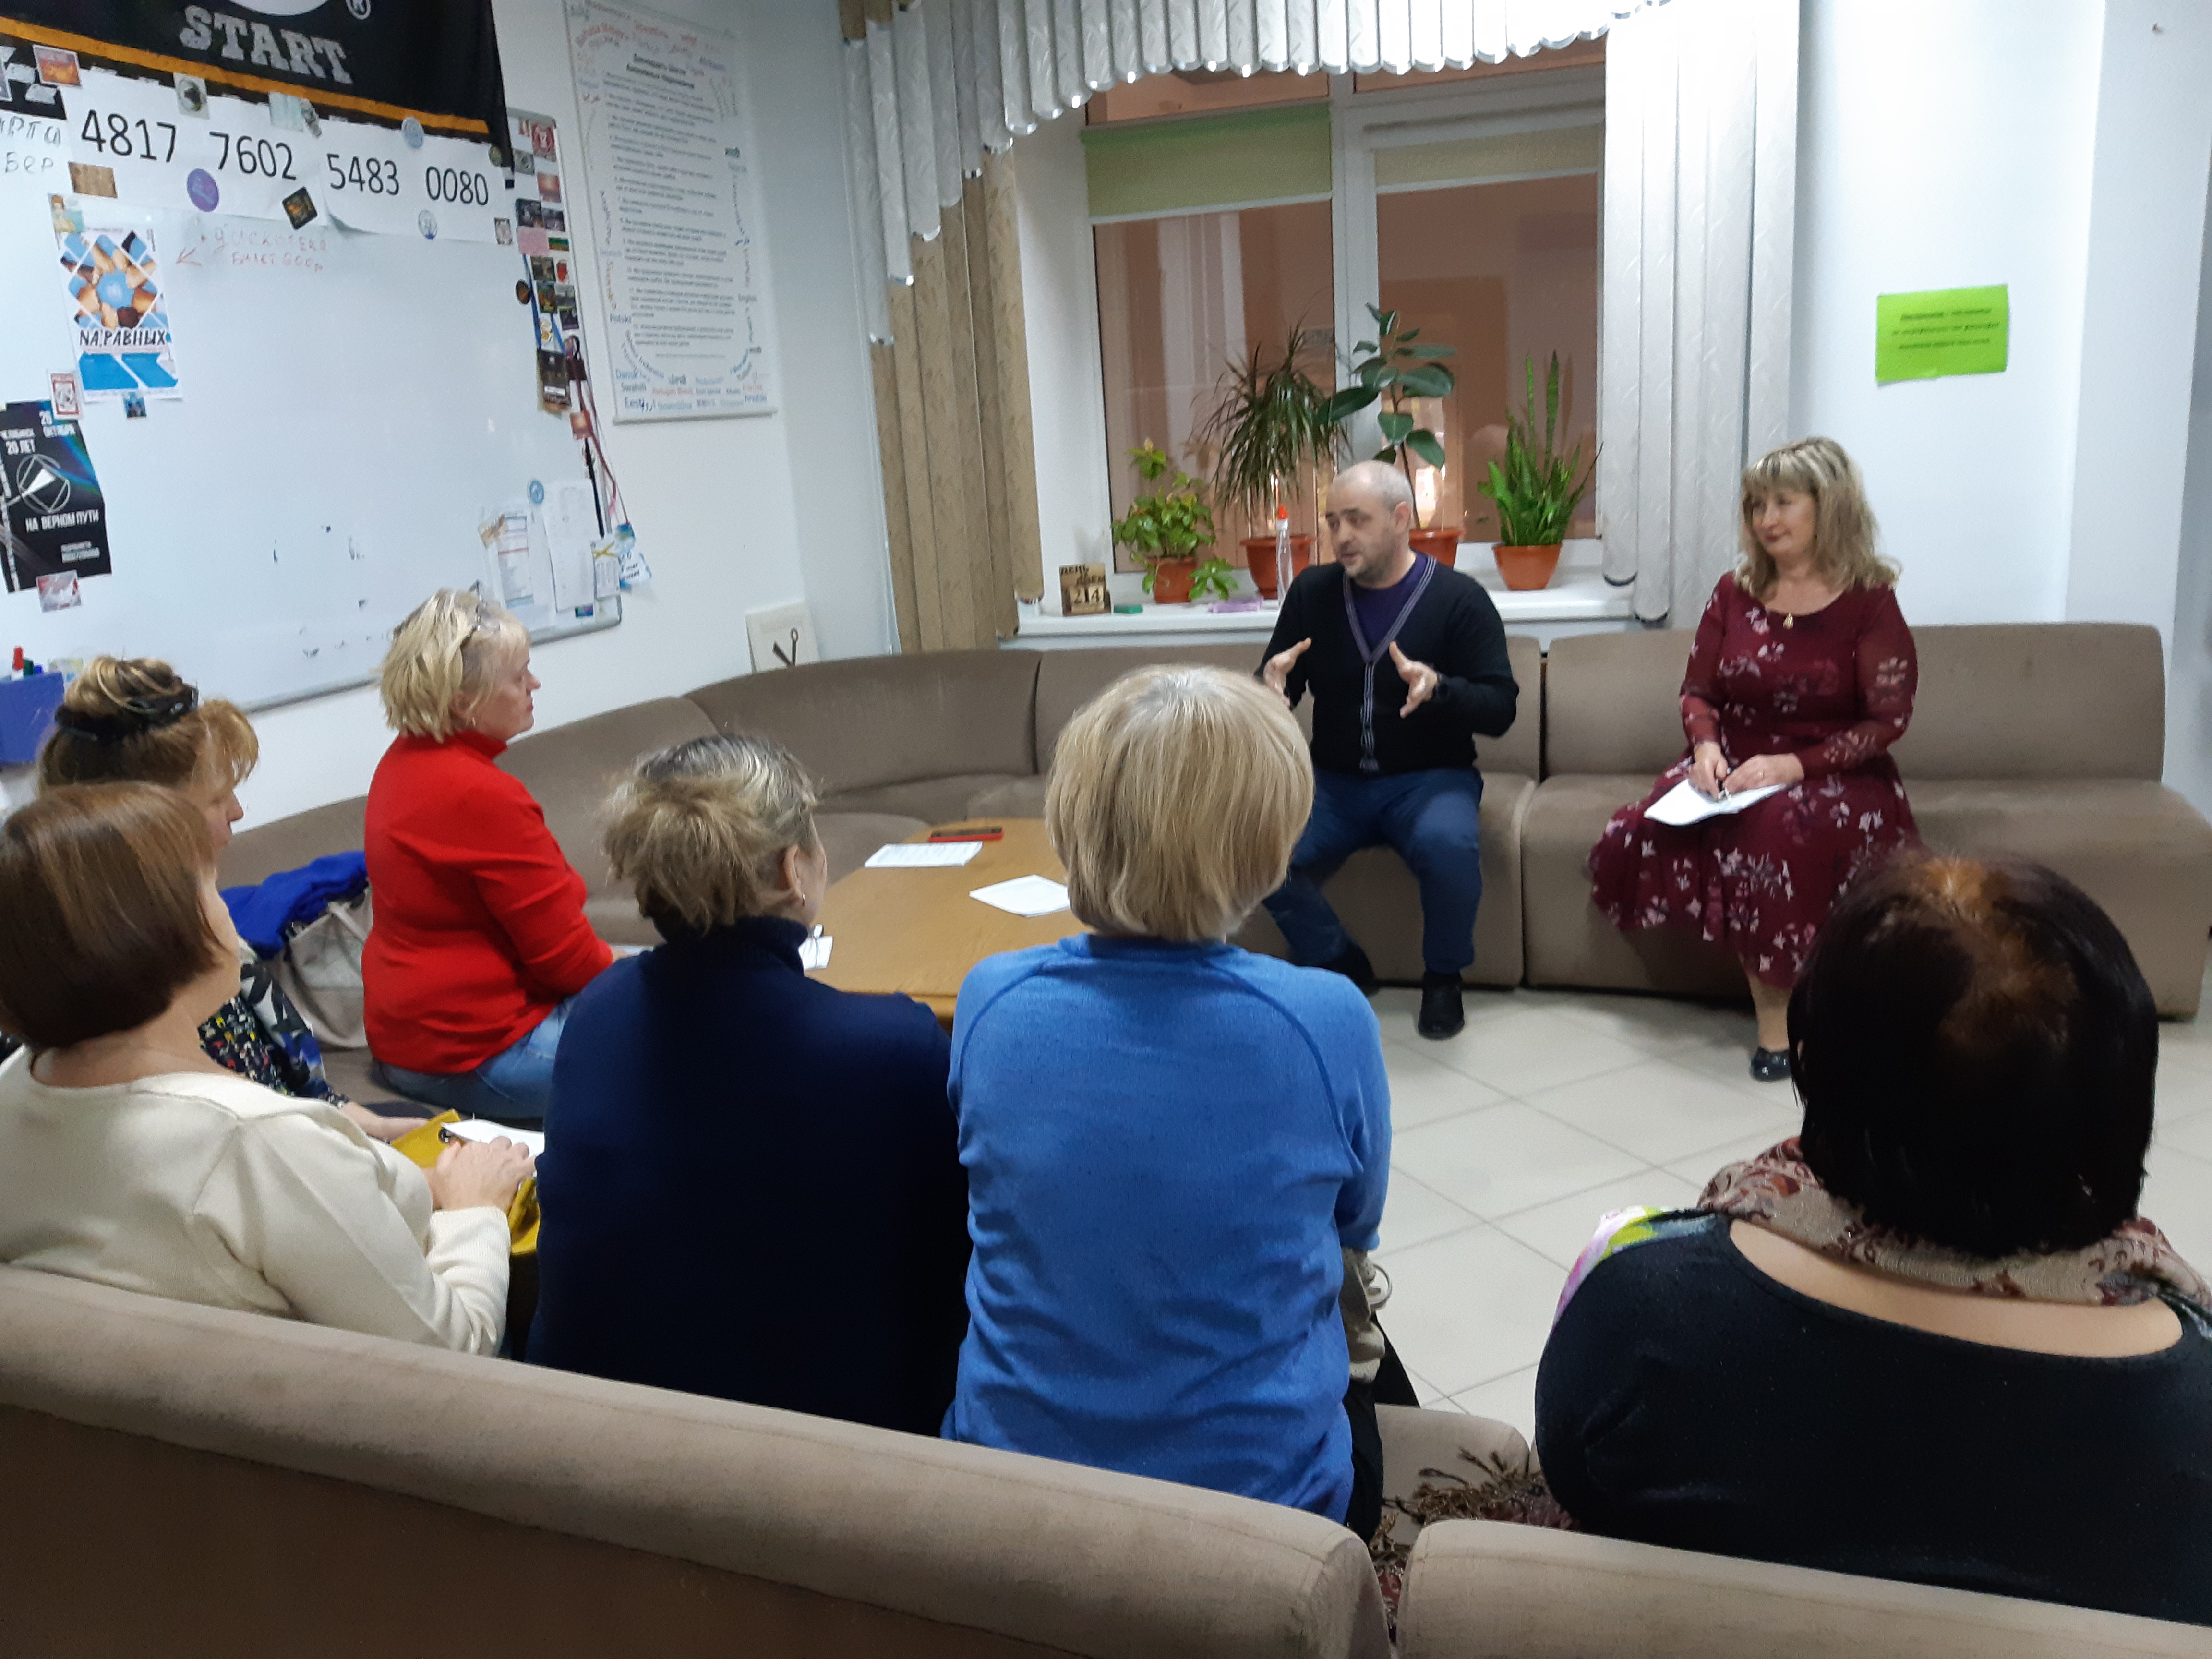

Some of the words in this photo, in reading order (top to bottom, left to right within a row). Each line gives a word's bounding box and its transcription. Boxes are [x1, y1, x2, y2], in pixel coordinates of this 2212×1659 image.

[179, 5, 353, 84] START
[81, 109, 176, 163] 4817
[209, 131, 297, 180] 7602
[326, 153, 399, 195] 5483
[425, 166, 489, 206] 0080
[25, 517, 39, 533] НА
[41, 512, 76, 530] ВЕРНОМ
[76, 509, 99, 525] ПУТИ
